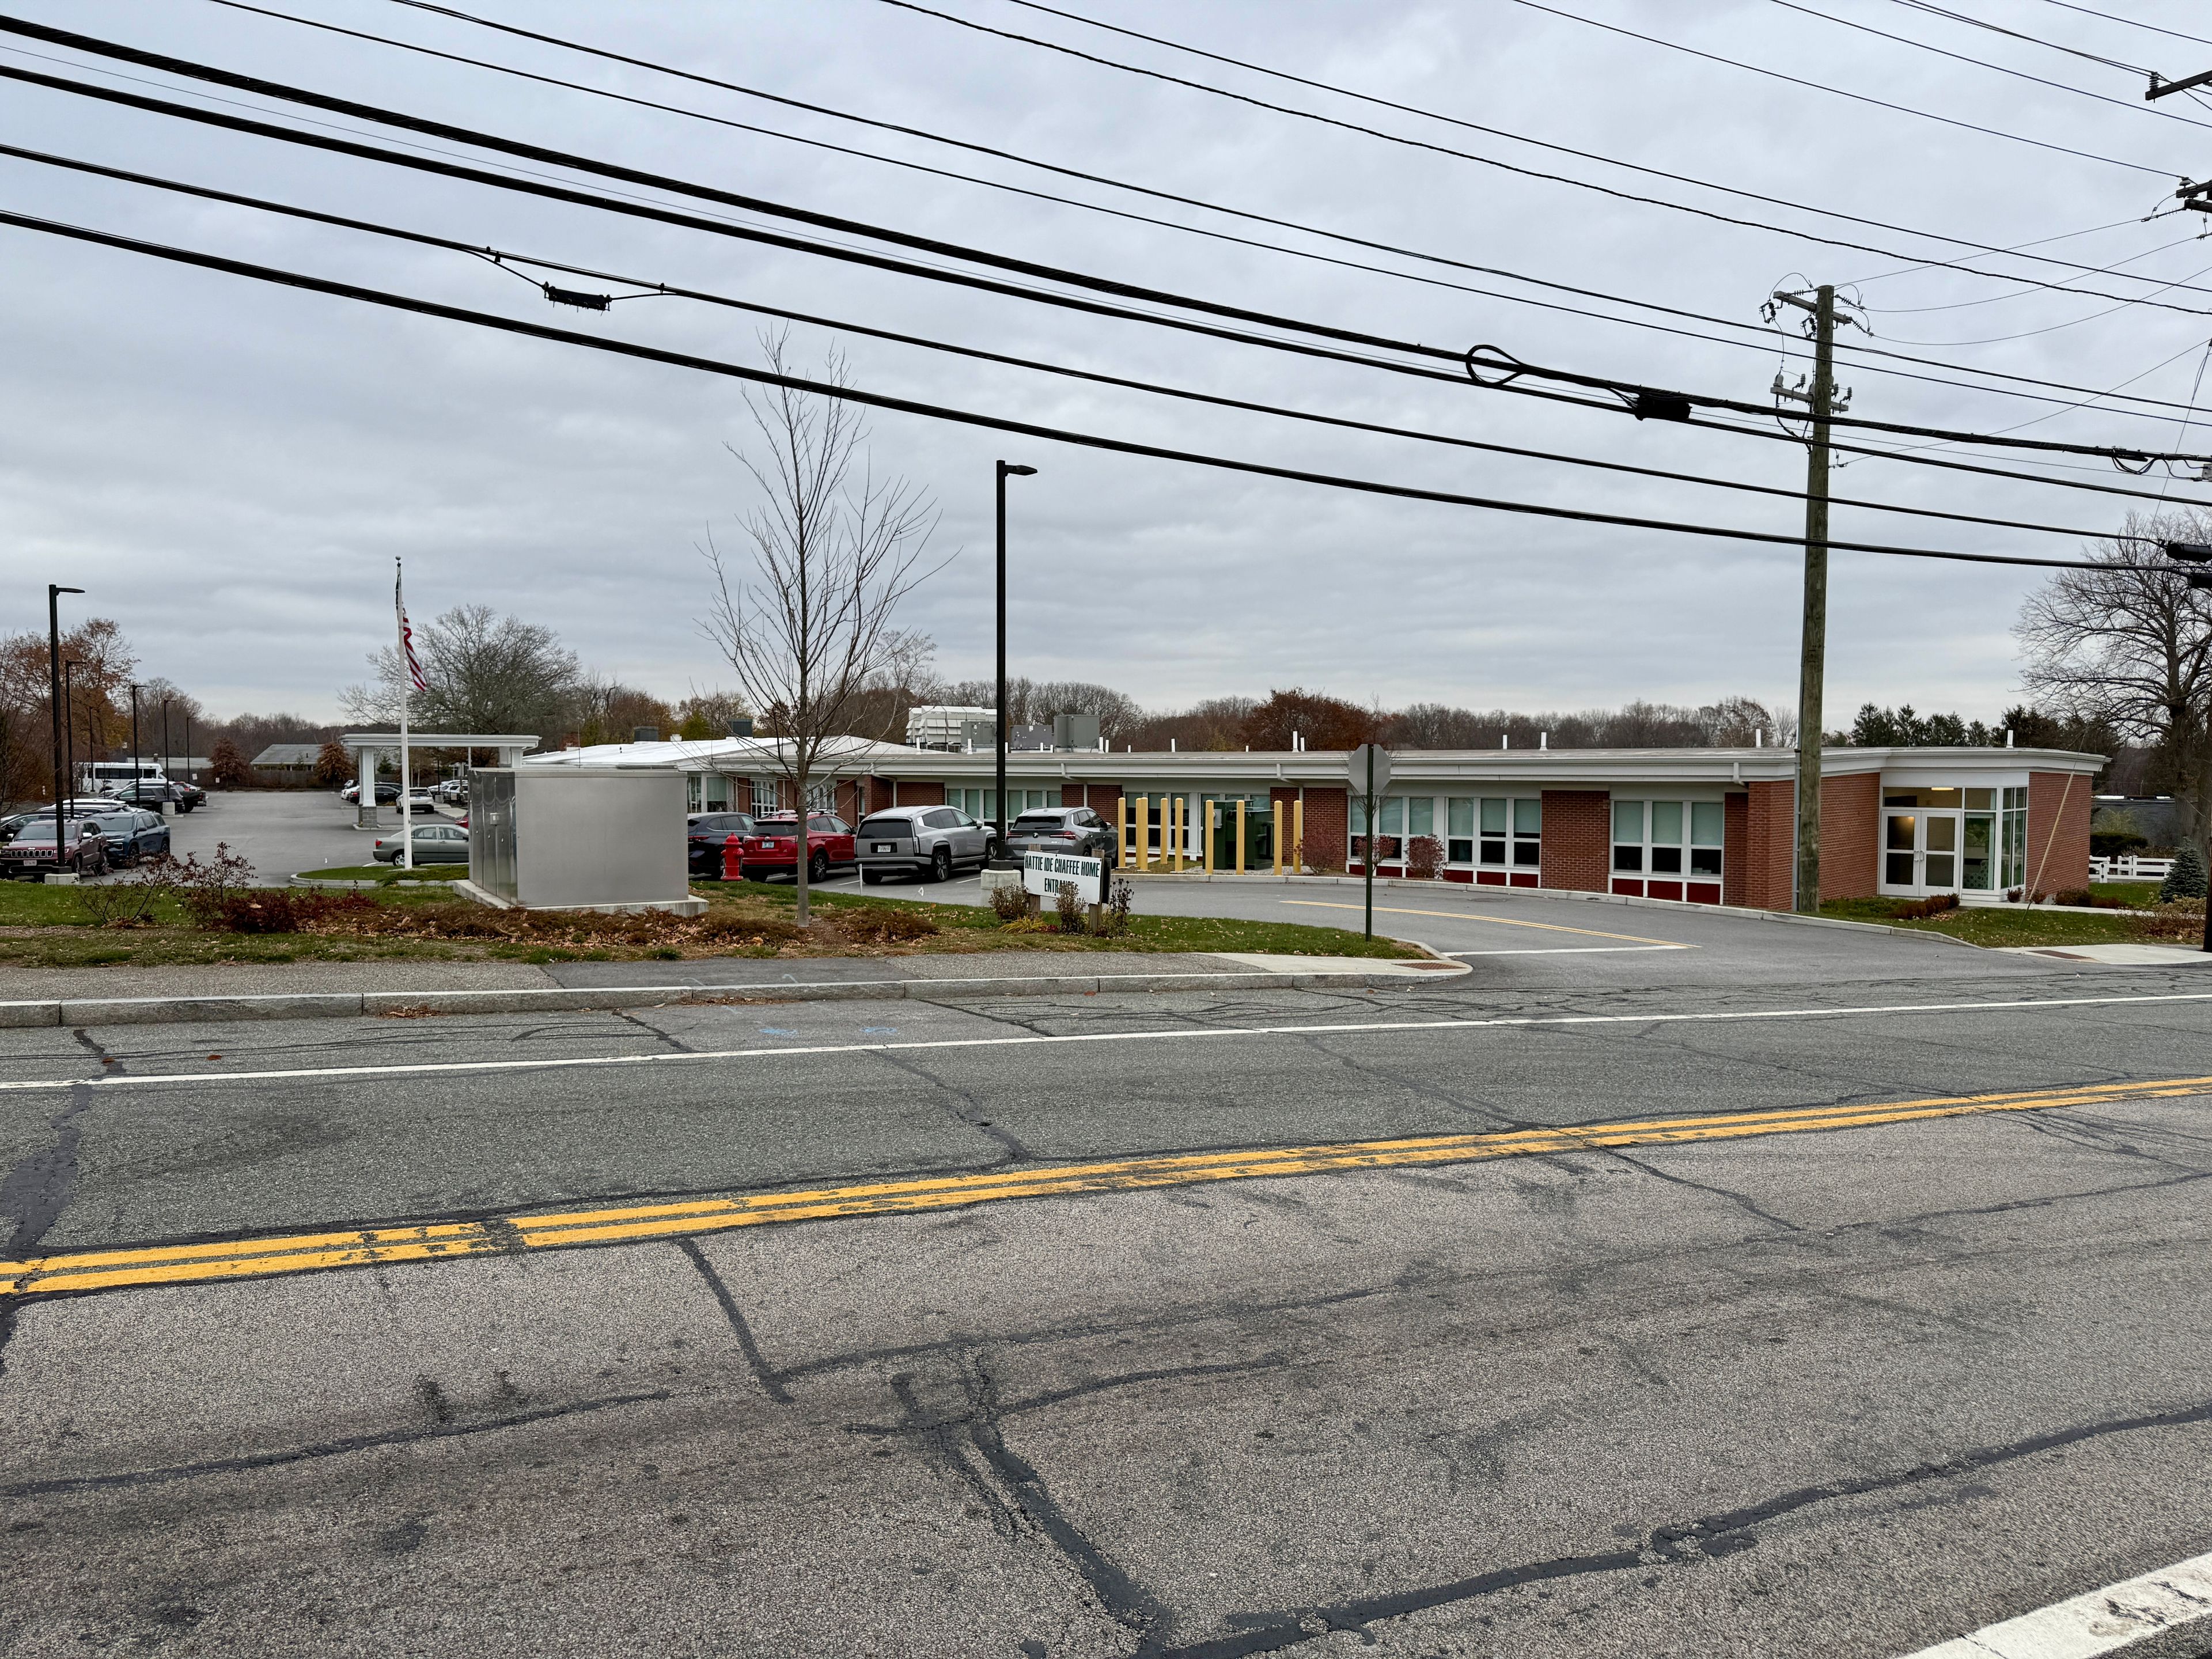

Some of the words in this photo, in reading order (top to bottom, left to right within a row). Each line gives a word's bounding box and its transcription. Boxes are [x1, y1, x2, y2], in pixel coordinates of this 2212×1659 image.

[1025, 855, 1043, 871] HATTIE
[1044, 857, 1053, 872] IDE
[1055, 858, 1080, 875] CHAFFEE
[1081, 861, 1100, 877] HOME
